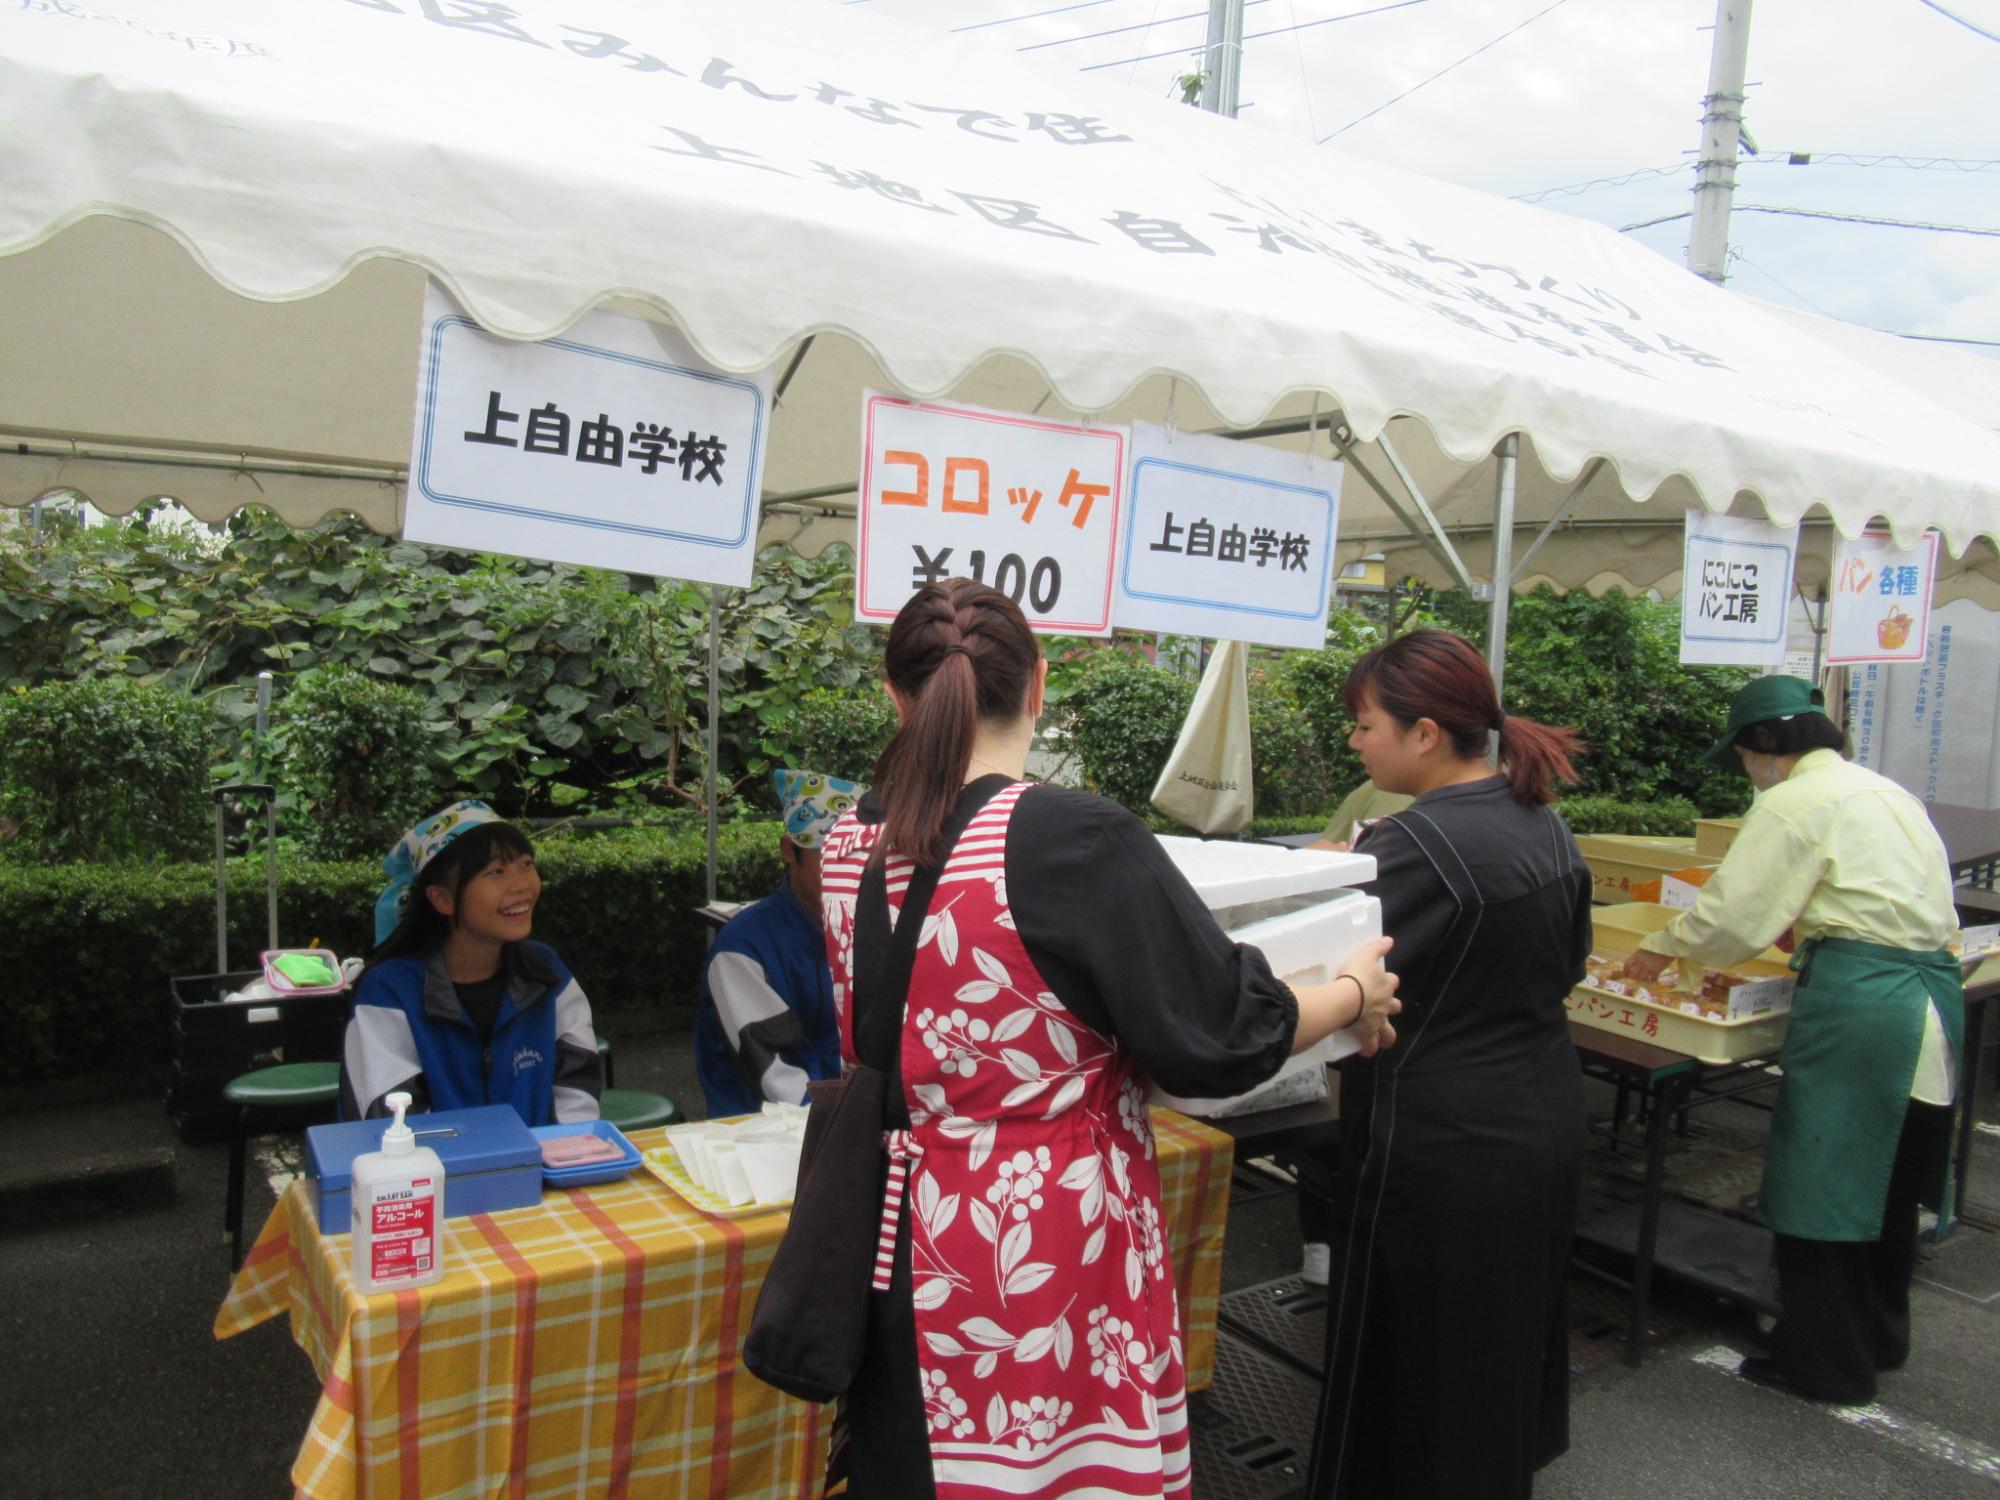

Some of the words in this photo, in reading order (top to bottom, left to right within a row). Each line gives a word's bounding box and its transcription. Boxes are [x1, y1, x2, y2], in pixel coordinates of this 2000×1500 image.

[464, 391, 728, 487] 上自由学校
[881, 449, 1110, 530] コロッケ
[1149, 511, 1311, 573] 上自由学校
[1701, 558, 1759, 590] にこにこ
[1838, 557, 1874, 594] パン
[1878, 565, 1919, 597] 各種
[1698, 592, 1760, 624] パン工房
[376, 1209, 424, 1224] アルコール
